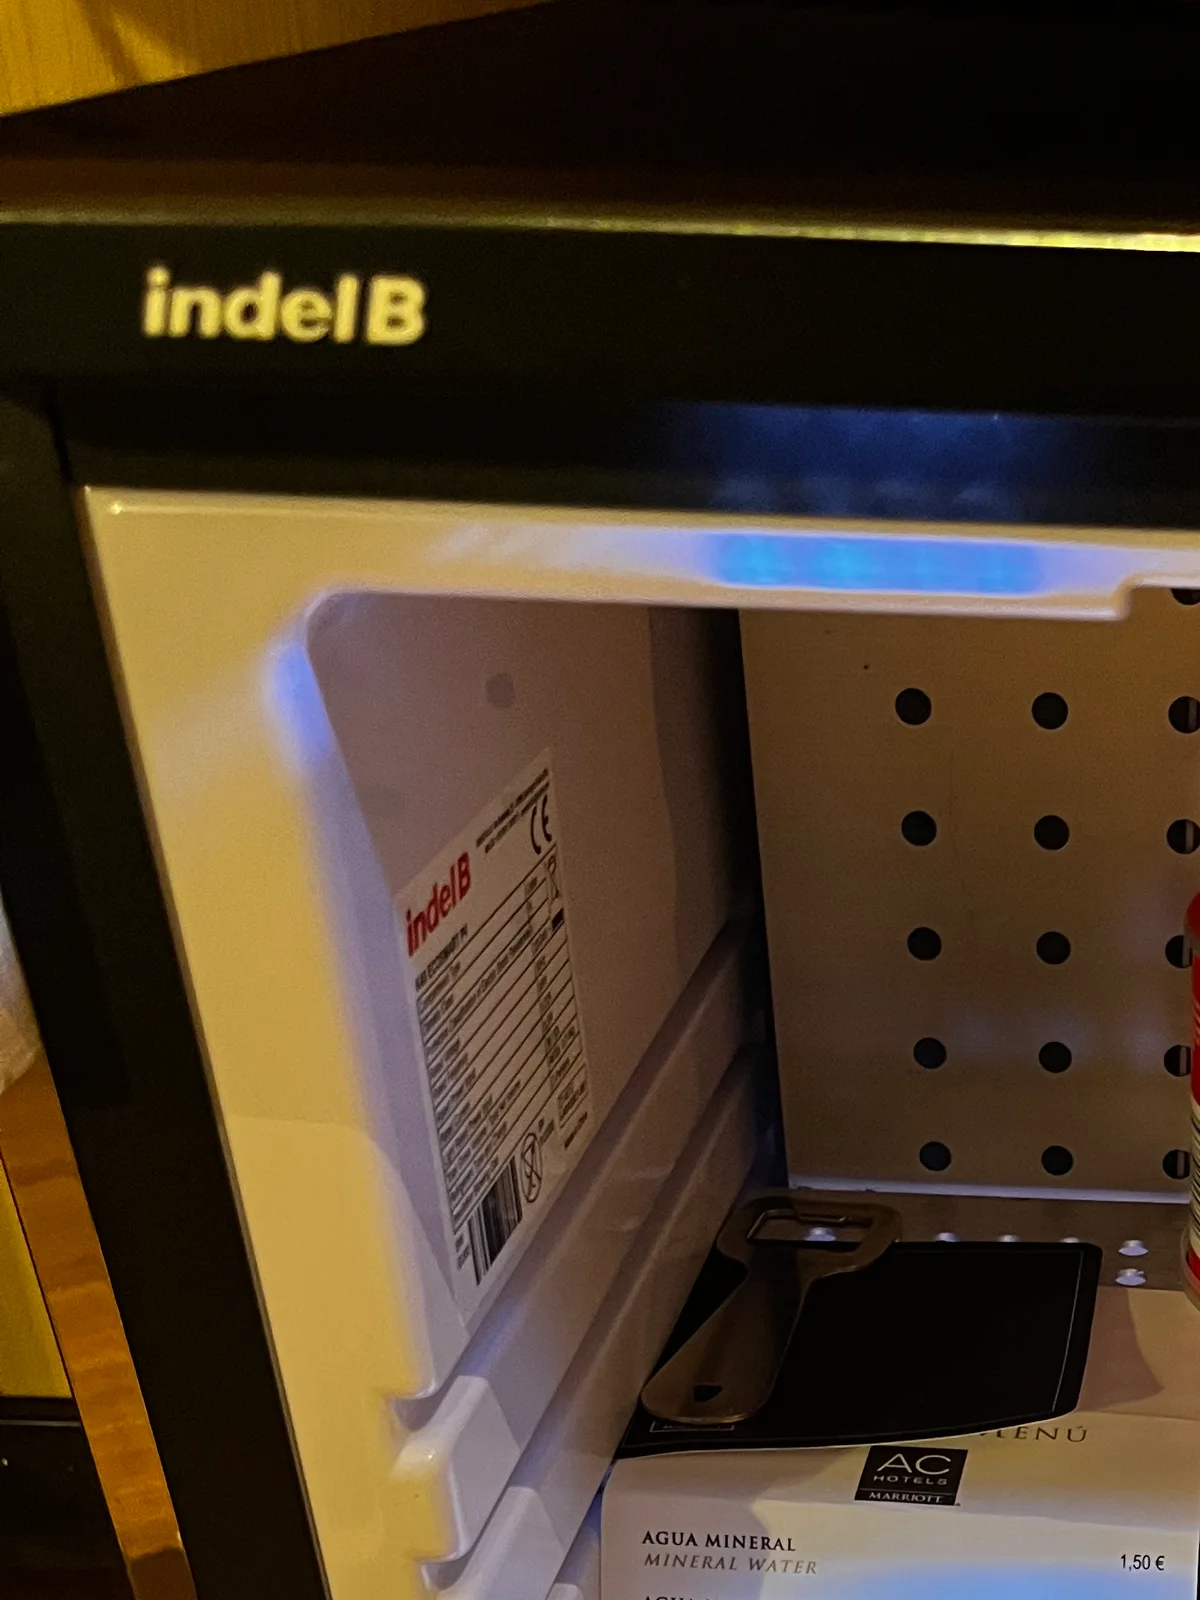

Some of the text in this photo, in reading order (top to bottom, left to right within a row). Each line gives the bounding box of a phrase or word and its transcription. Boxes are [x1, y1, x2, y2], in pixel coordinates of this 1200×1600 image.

[876, 1453, 952, 1476] AC
[873, 1475, 948, 1486] HOTELS
[868, 1492, 944, 1504] MARRIOTT
[642, 1530, 1165, 1573] AGUA MINERAL 1,50 €
[644, 1552, 818, 1576] MINERAL WATER
